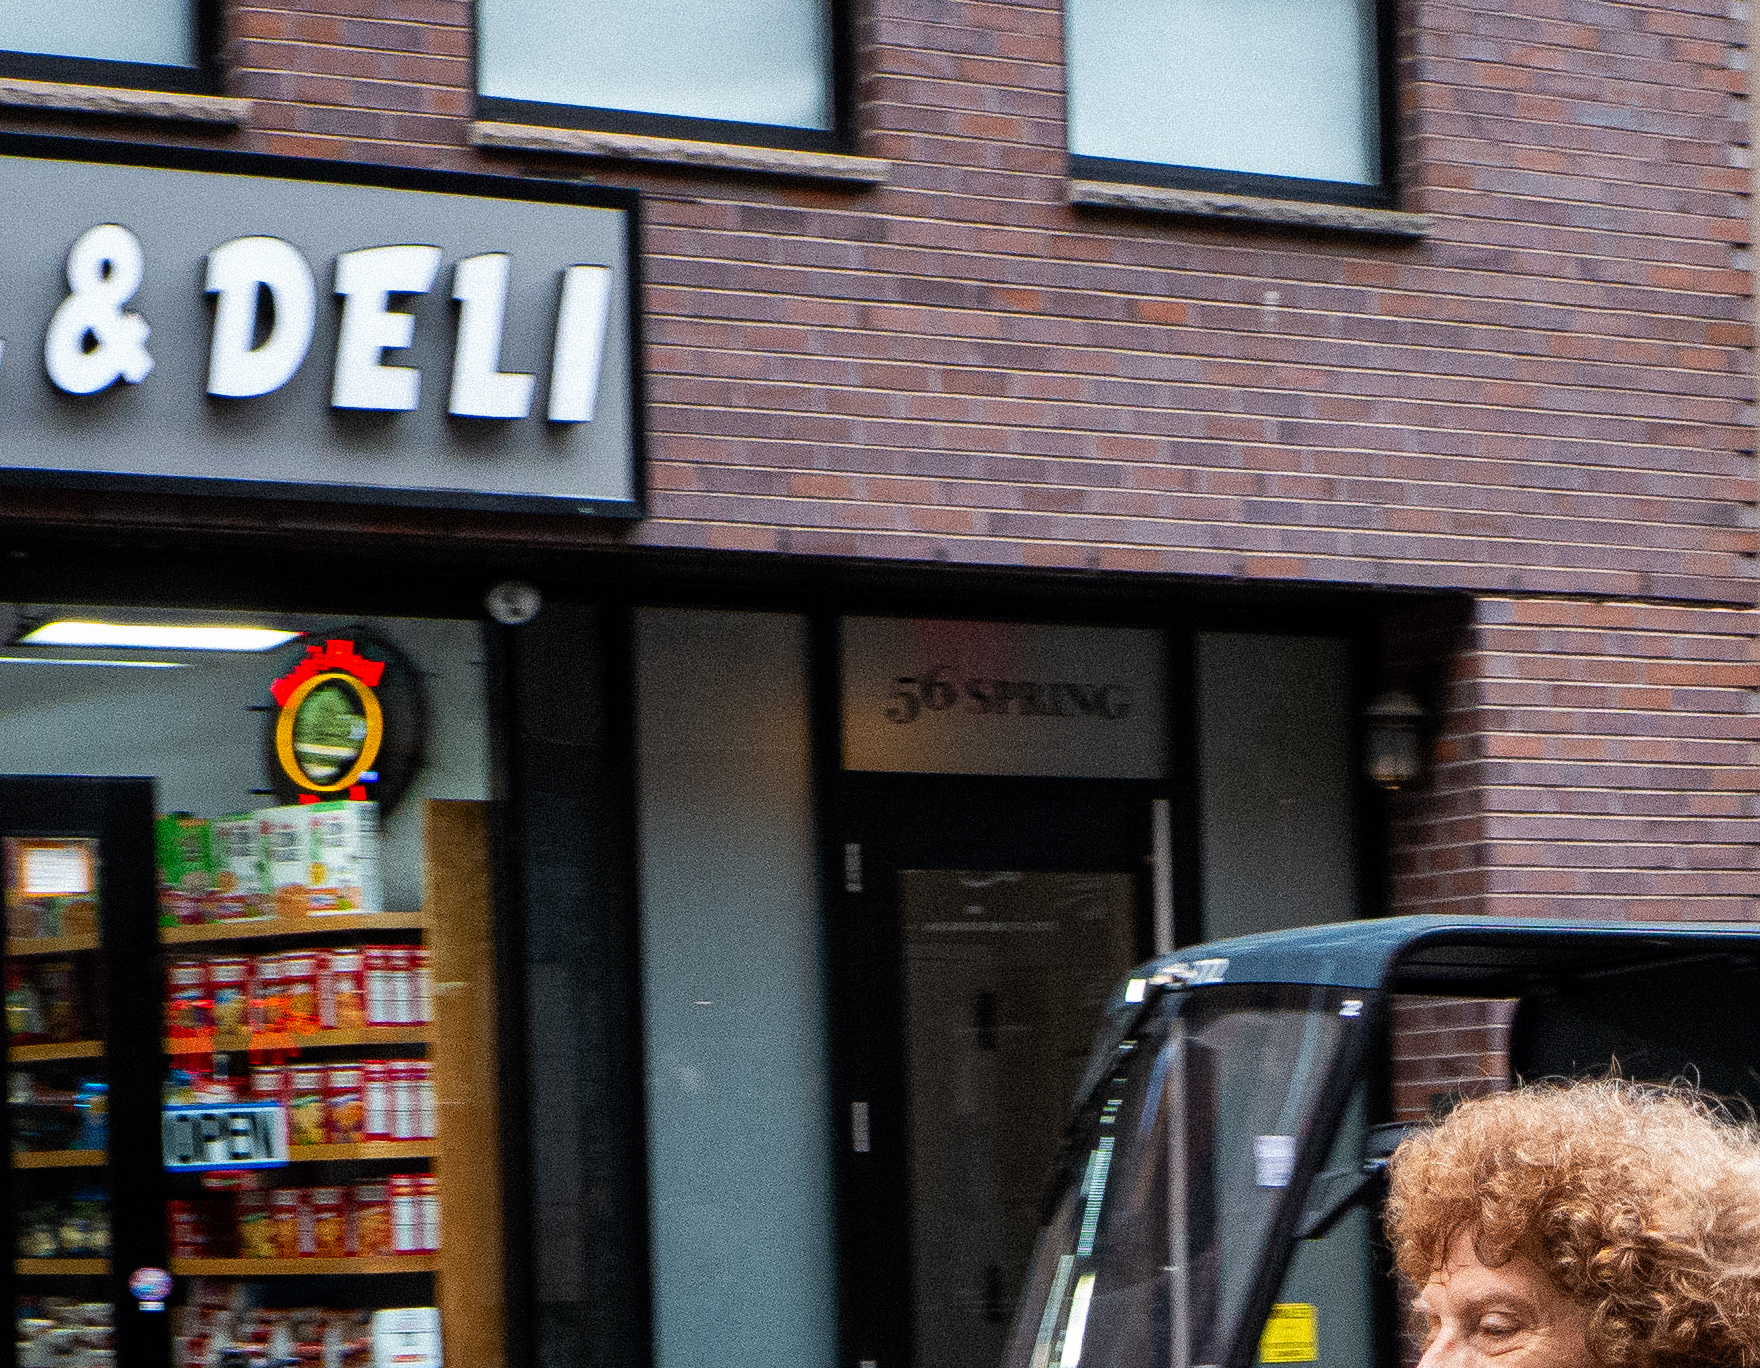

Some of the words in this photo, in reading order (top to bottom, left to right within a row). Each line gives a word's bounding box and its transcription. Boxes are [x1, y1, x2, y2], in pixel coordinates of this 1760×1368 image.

[44, 222, 156, 397] &
[205, 234, 612, 423] DELI
[884, 663, 957, 724] 56
[964, 677, 1132, 720] SPRING
[168, 1111, 274, 1164] OPEN
